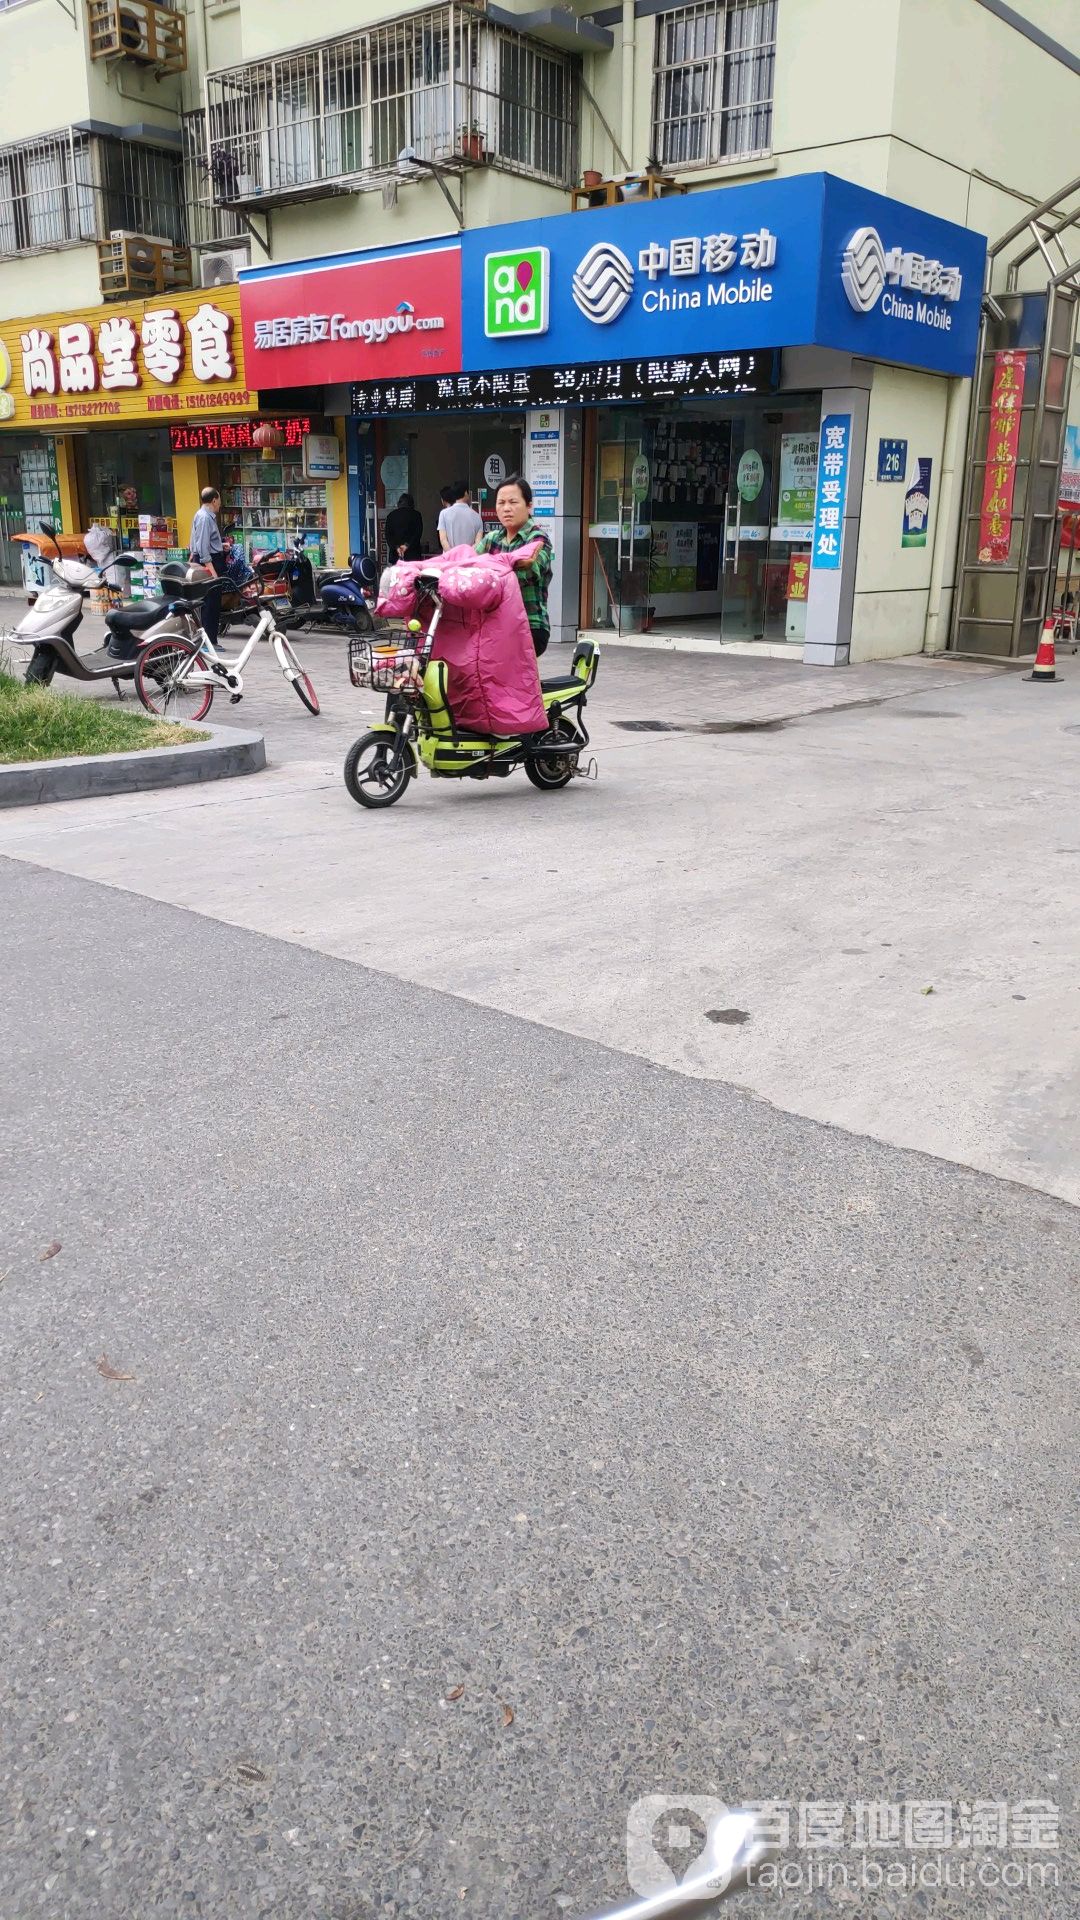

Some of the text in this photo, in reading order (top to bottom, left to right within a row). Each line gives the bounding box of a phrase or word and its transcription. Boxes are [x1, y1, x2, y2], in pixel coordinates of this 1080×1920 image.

[639, 227, 777, 280] 中国移动
[885, 247, 962, 301] 中国移动
[642, 278, 772, 313] China Mobile
[881, 294, 952, 330] China Mobile
[254, 313, 330, 349] 易居房友
[20, 302, 235, 397] 尚品堂零食
[489, 458, 500, 475] 租
[885, 453, 900, 472] 216
[816, 425, 846, 556] 宽带受理处
